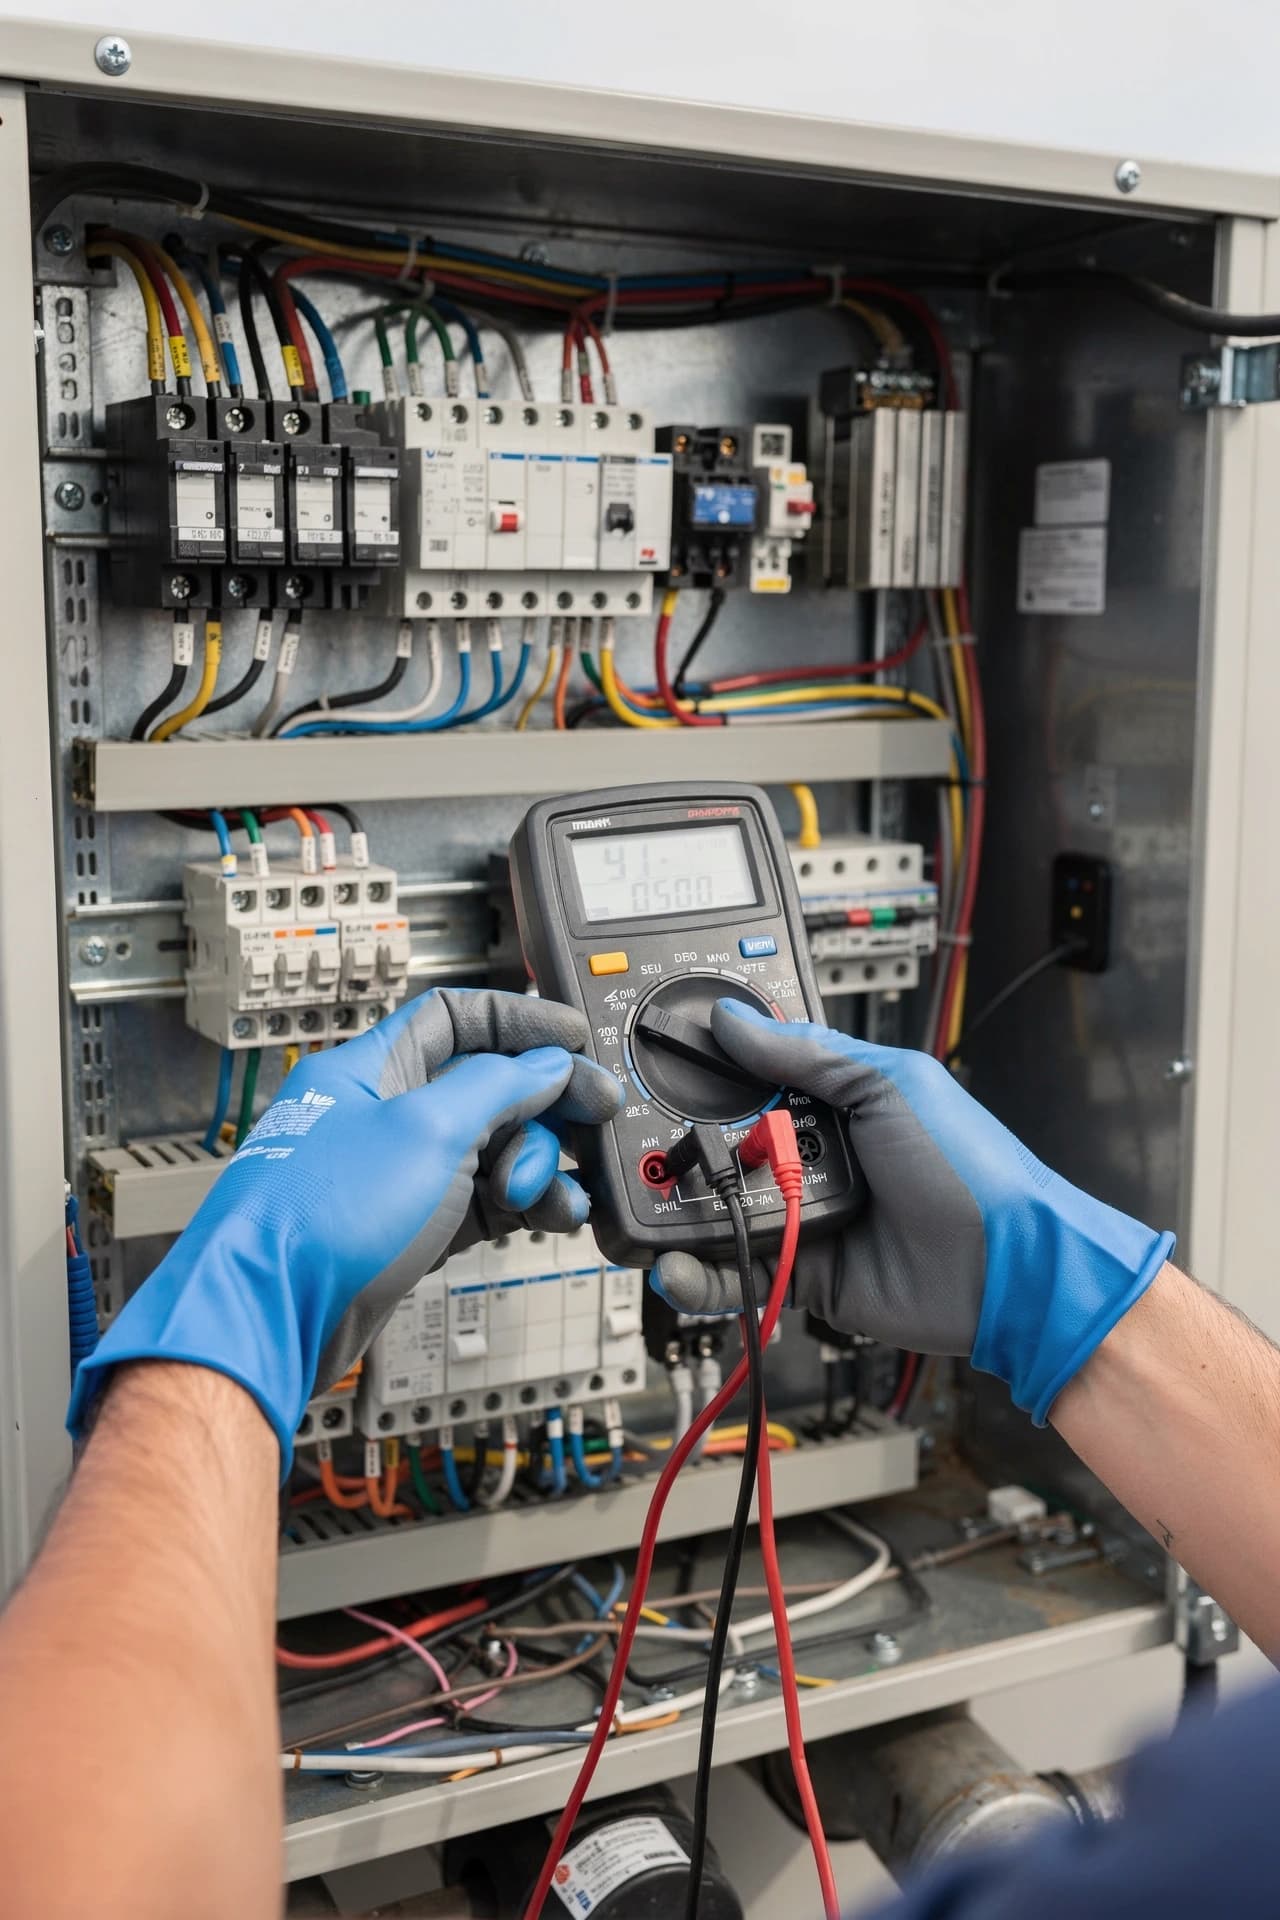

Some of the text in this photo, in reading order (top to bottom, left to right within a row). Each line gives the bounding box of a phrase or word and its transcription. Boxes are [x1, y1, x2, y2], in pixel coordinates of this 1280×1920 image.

[640, 963, 662, 975] SEU
[598, 1026, 618, 1037] 200
[654, 1201, 682, 1215] SHIL
